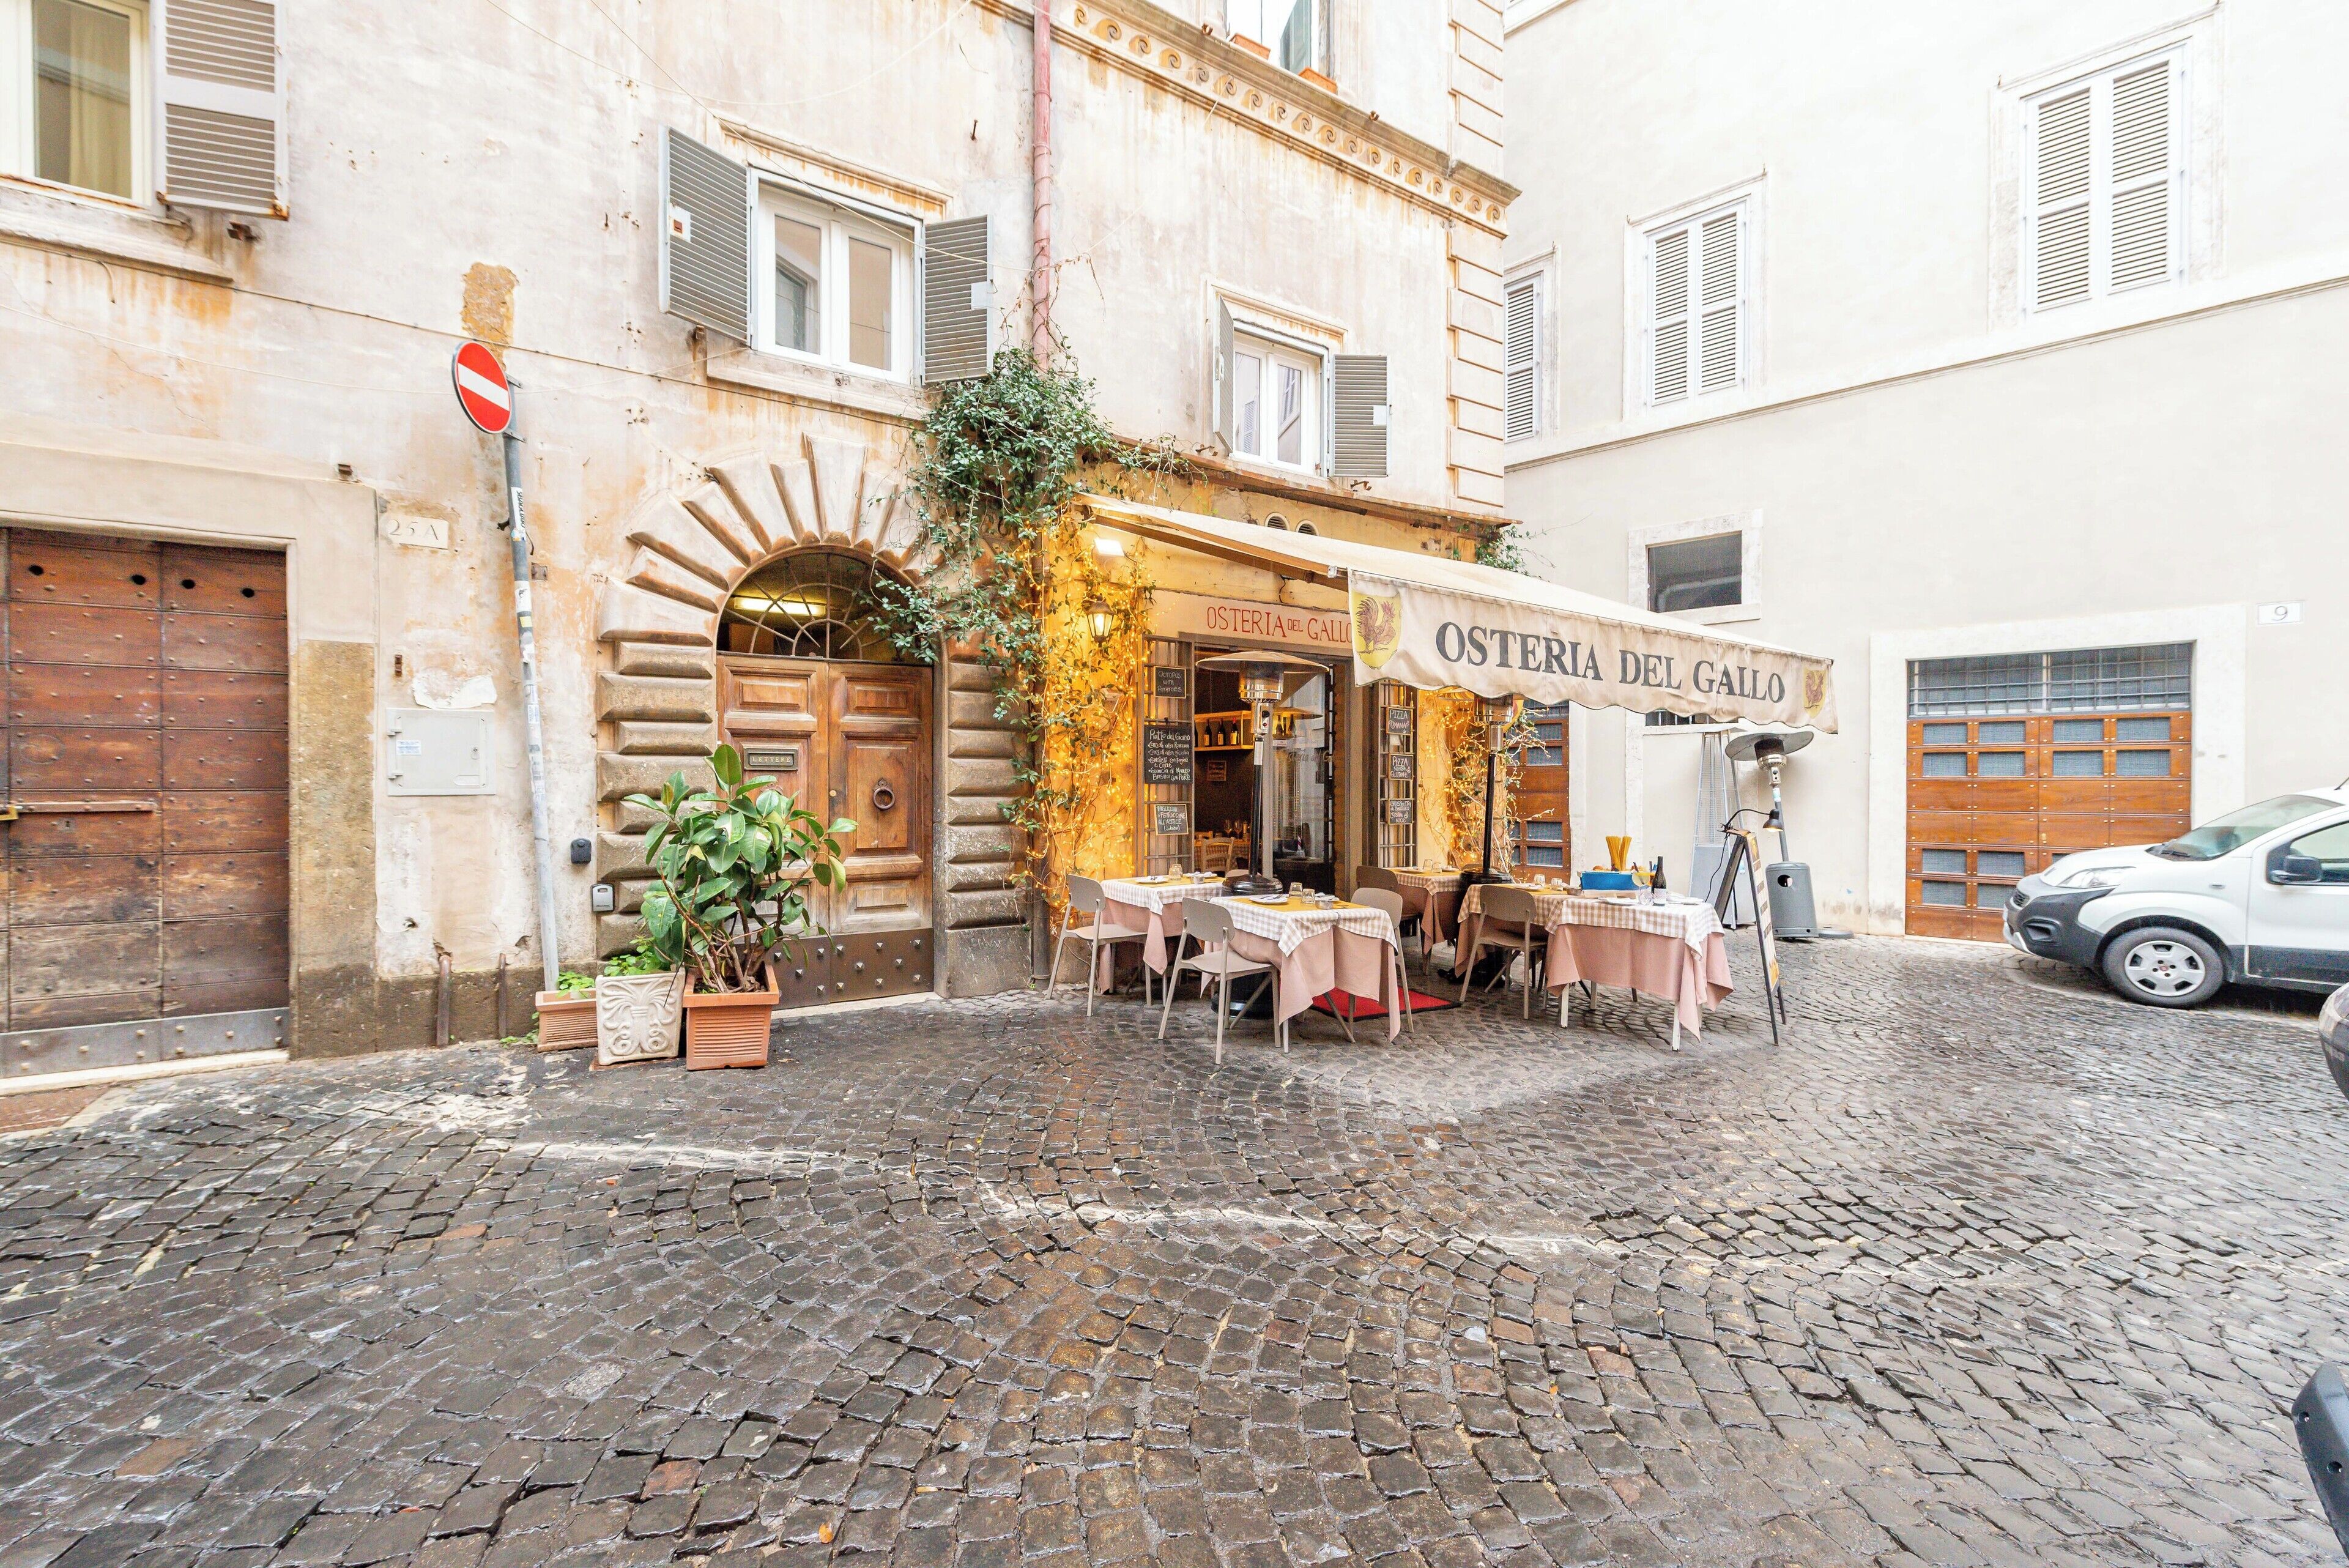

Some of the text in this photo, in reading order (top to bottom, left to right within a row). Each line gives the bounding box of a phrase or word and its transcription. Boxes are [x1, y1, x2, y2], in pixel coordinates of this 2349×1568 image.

[2271, 606, 2287, 622] 9
[1207, 606, 1287, 637] OSTERIA
[1287, 619, 1304, 633] DEL
[1436, 622, 1786, 704] OSTERIA DEL GALLO
[1158, 671, 1181, 679] OCTOPUS
[1389, 710, 1408, 719] PIZZA
[1389, 720, 1406, 729] ROMANA
[1150, 729, 1167, 740] Piatto
[1167, 730, 1175, 740] del
[1392, 756, 1408, 767] PIZZA
